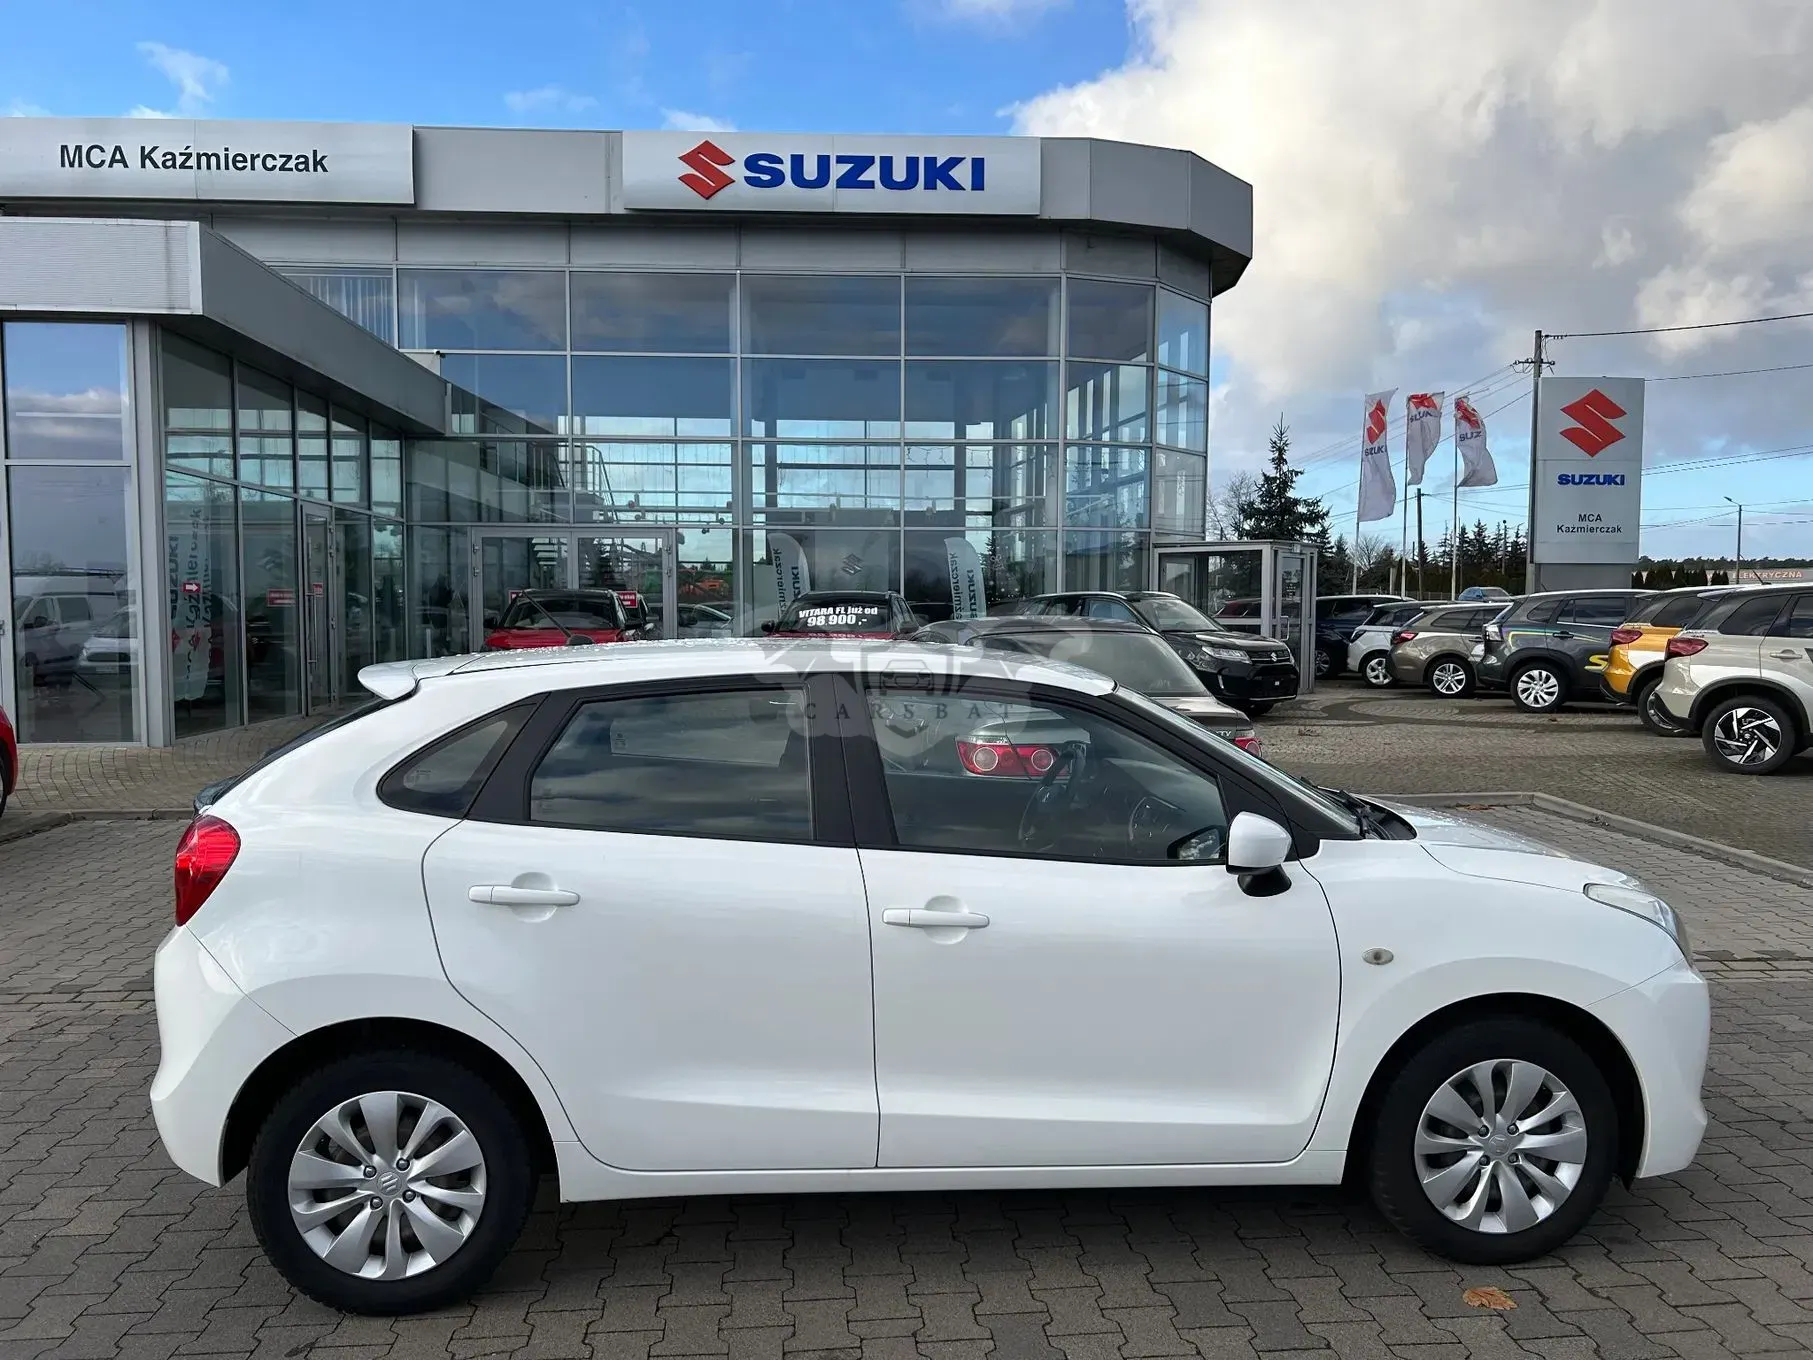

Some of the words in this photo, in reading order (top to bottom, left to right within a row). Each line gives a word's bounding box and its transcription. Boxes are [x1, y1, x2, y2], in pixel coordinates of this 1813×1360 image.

[60, 144, 129, 169] MCA
[140, 145, 329, 173] Kaźmierczak
[743, 152, 985, 192] SUZUKI
[1557, 473, 1625, 486] SUZUKI
[1578, 513, 1602, 523] MCA
[798, 607, 834, 618] VITARA
[835, 606, 846, 615] FL
[864, 607, 878, 615] od
